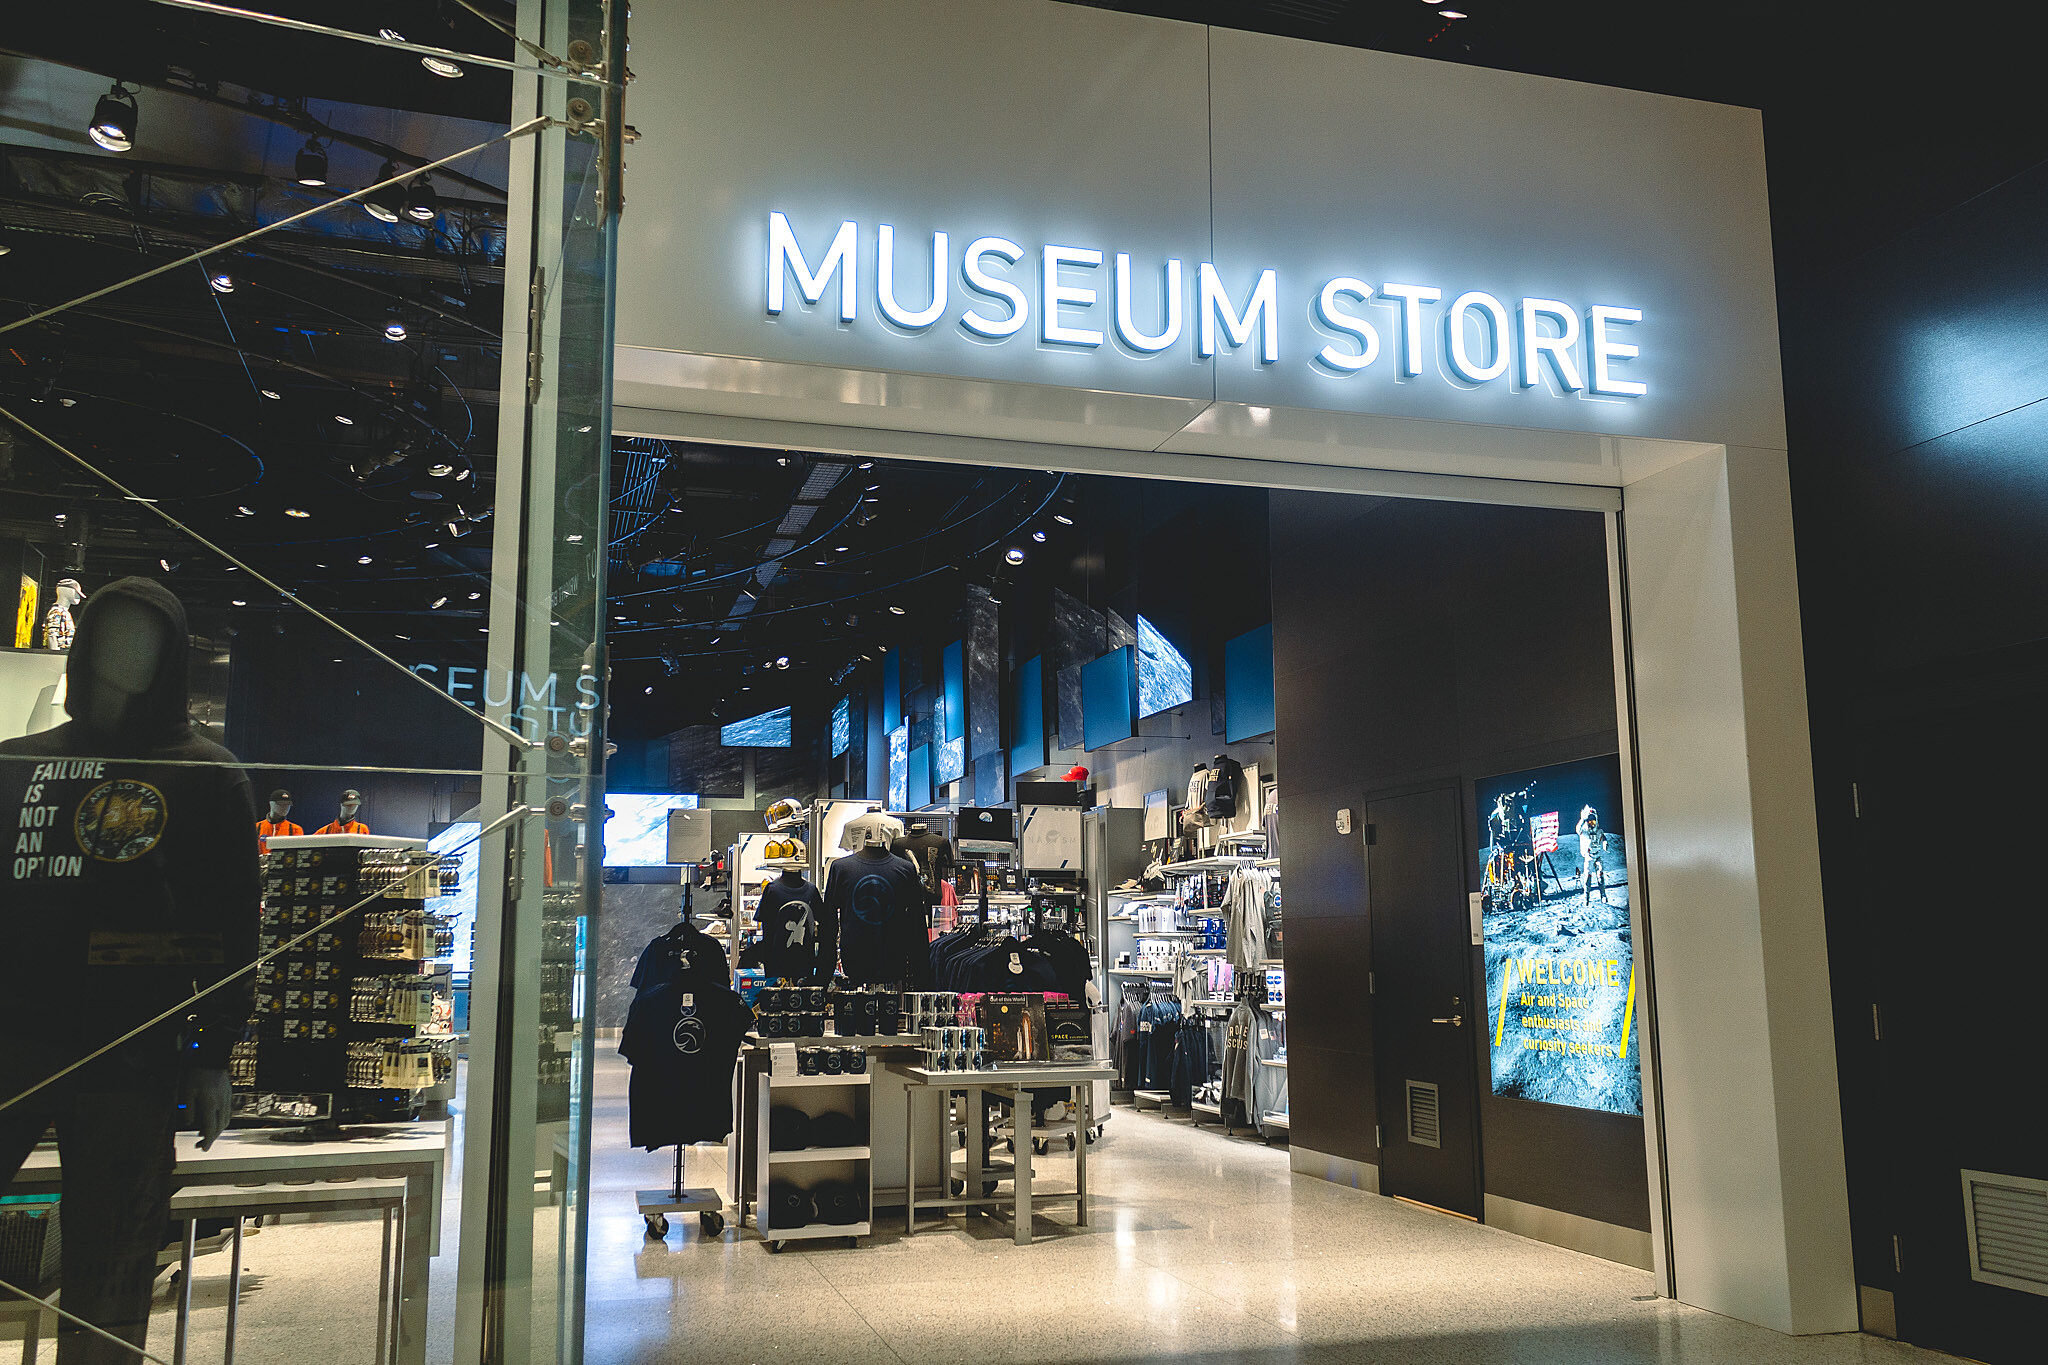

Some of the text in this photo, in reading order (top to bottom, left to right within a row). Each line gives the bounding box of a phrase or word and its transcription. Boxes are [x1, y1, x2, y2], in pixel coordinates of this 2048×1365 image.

[766, 210, 1648, 398] MUSEUM STORE
[31, 760, 106, 782] FAILURE
[22, 783, 45, 804] IS
[18, 805, 60, 829] NOT
[14, 831, 43, 854] AN
[1515, 958, 1620, 987] WELCOME
[1520, 991, 1590, 1011] Air and Space
[1521, 1013, 1603, 1033] enthusiasts and
[1523, 1035, 1613, 1057] curiosity seekers
